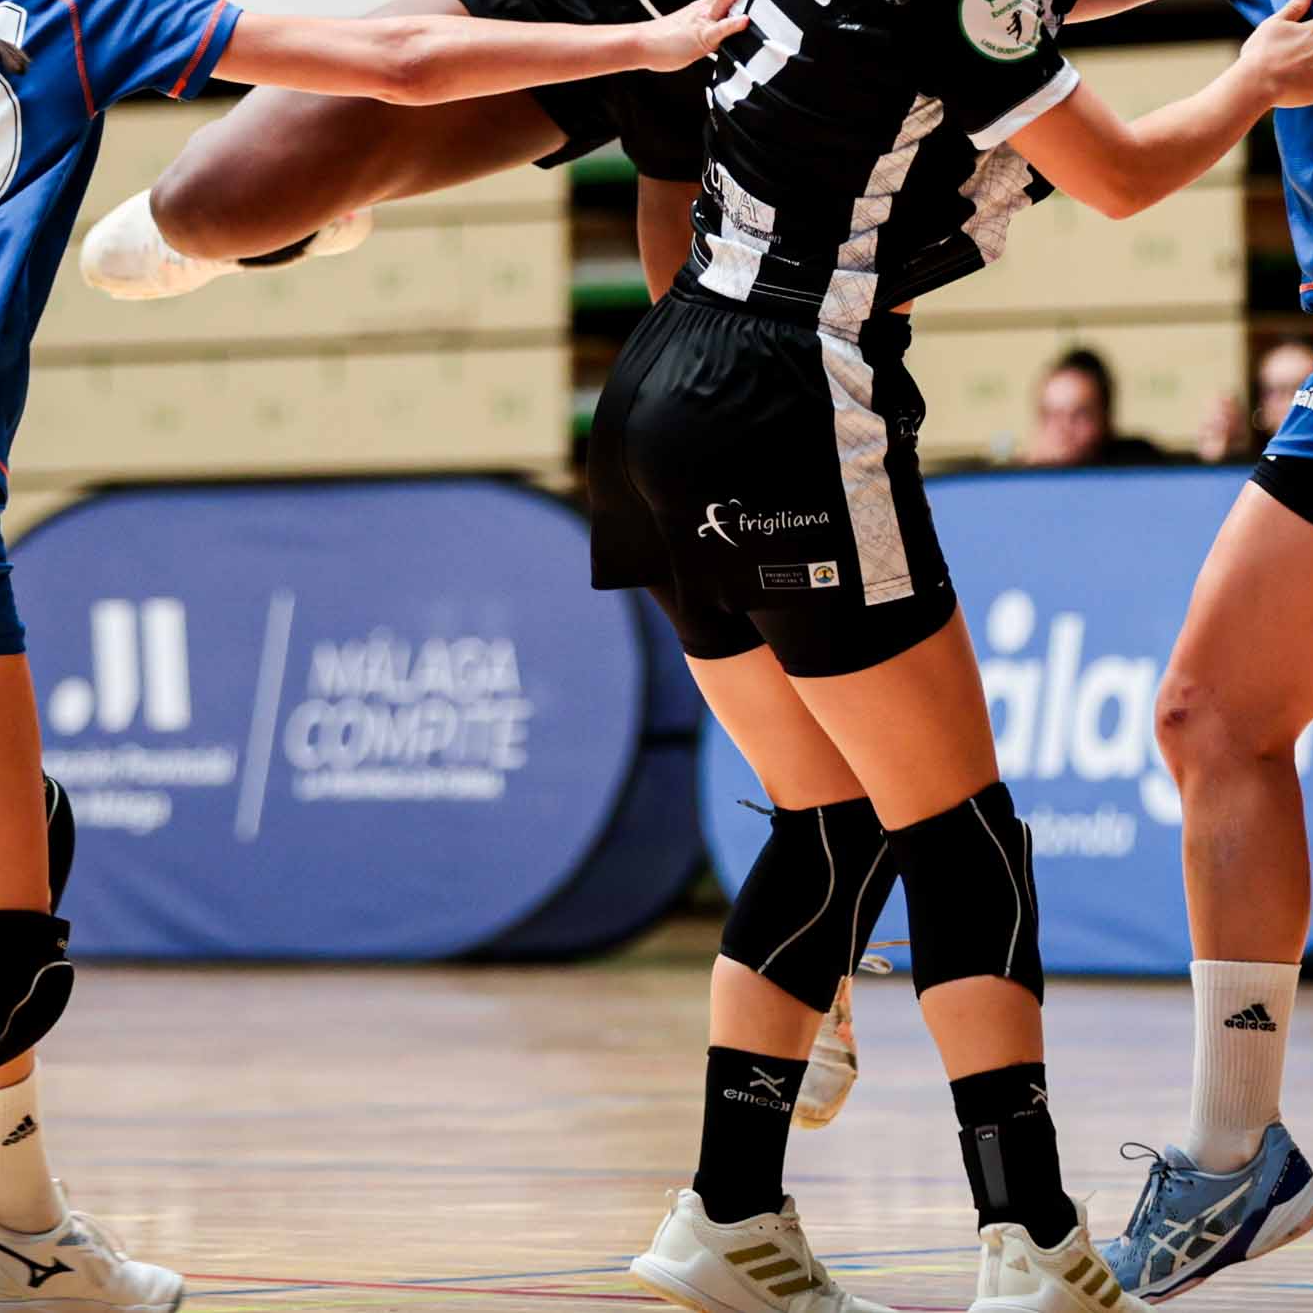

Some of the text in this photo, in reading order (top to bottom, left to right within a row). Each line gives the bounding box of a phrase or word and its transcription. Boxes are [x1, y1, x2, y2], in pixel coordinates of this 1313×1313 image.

[738, 510, 831, 536] frigiliana
[306, 628, 524, 700] MÁLAGA
[284, 698, 536, 770] COMPITE
[1224, 1018, 1277, 1032] adidas
